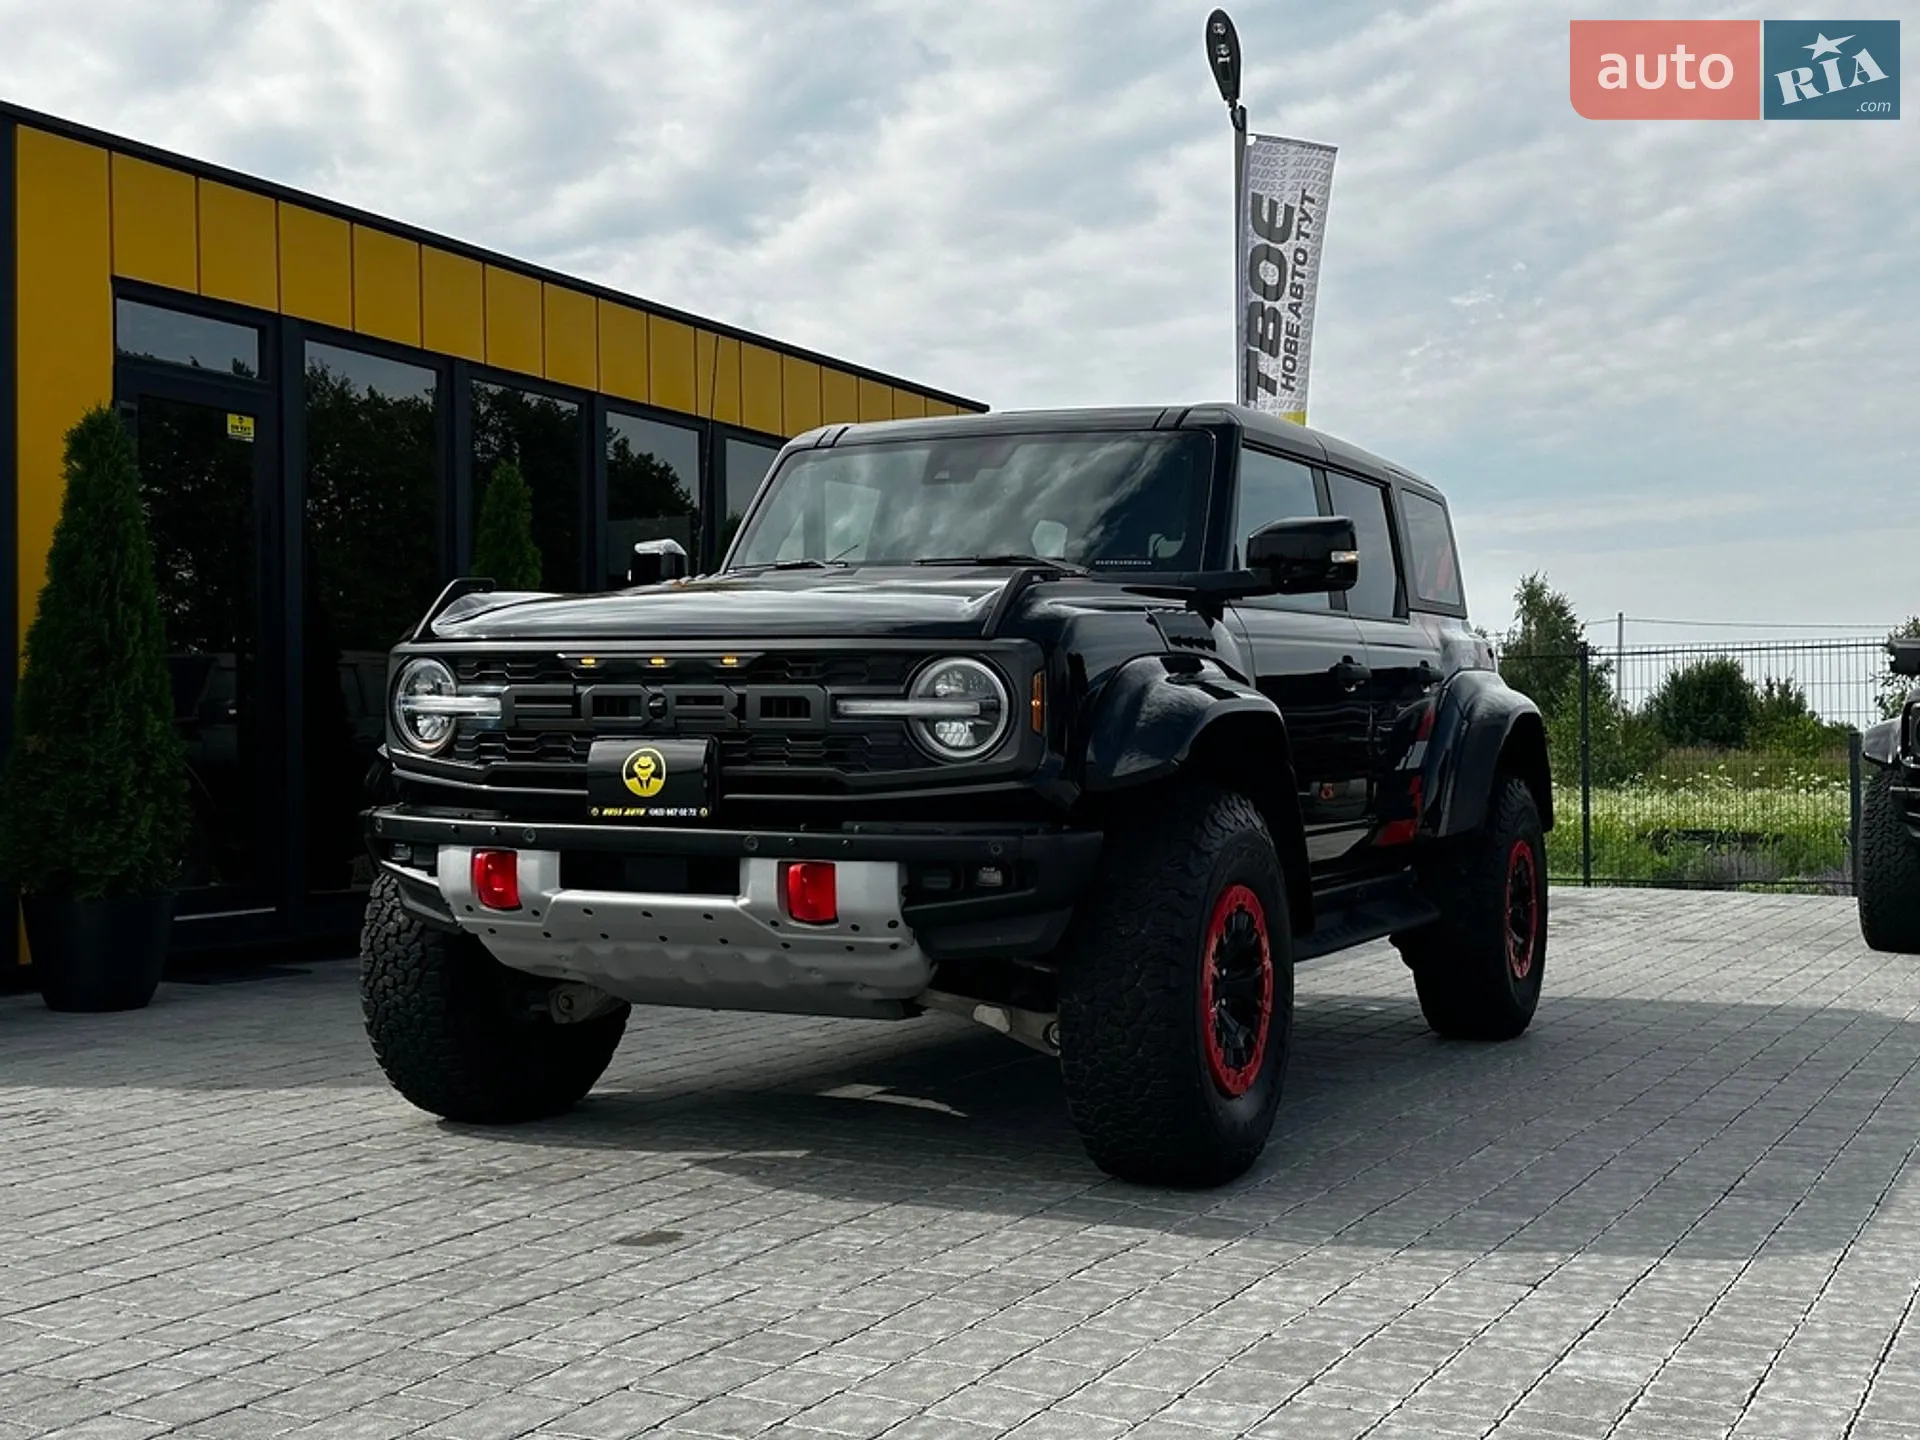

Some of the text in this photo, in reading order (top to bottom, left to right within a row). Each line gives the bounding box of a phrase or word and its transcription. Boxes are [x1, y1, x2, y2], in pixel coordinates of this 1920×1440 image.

[1297, 188, 1316, 241] ТУТ
[1287, 246, 1308, 321] АВТО
[1280, 321, 1300, 392] НОВЕ
[501, 682, 827, 731] FORD
